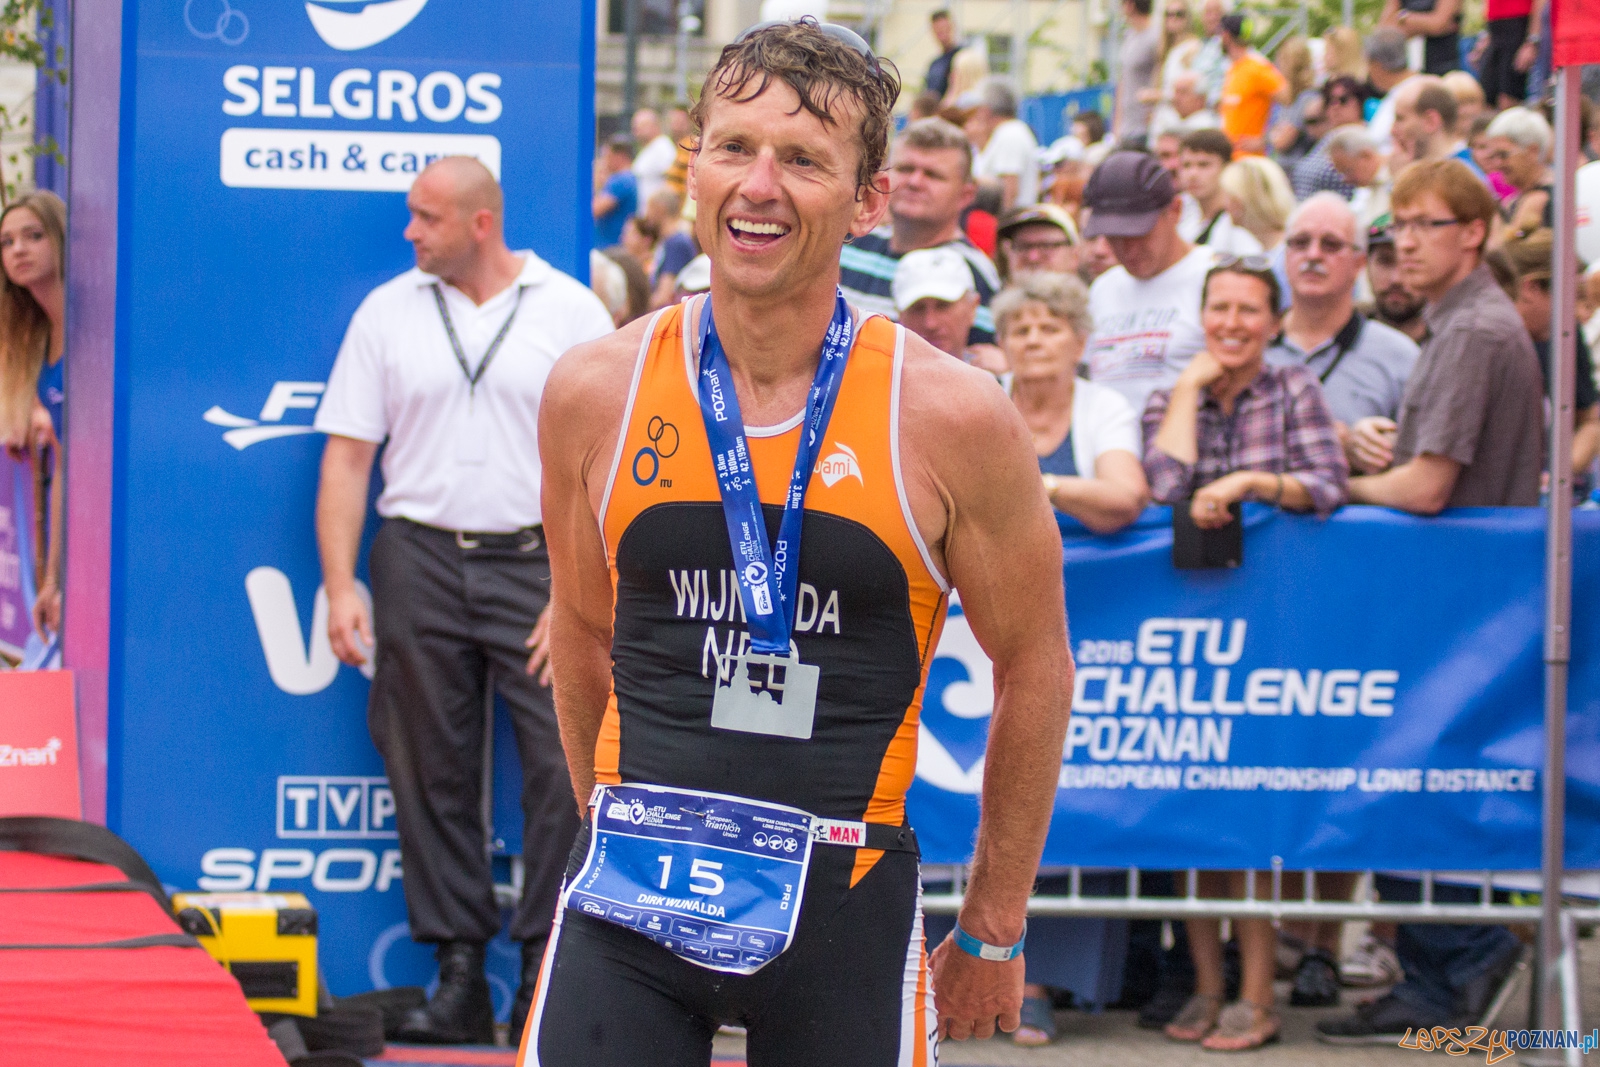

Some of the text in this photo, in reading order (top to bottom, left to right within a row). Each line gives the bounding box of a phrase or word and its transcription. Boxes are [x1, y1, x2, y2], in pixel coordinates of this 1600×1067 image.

[222, 65, 503, 124] SELGROS
[244, 143, 329, 170] cash
[341, 144, 367, 172] &
[717, 453, 729, 478] 3,8km
[727, 449, 739, 475] 180km
[735, 435, 750, 472] 42,195km
[791, 484, 803, 509] 3,8km
[741, 521, 755, 562] CHALLENGE
[669, 569, 841, 634] WIJNDA
[1076, 618, 1247, 665] 2016 ETU
[1072, 666, 1399, 717] CHALLENGE
[1063, 715, 1233, 762] POZNAN
[1058, 764, 1535, 792] EUROPEAN CHAMPIONSHIP LONG DISTANCE
[286, 787, 397, 829] TVP
[704, 820, 741, 833] Triathlon
[722, 831, 738, 839] Union
[829, 826, 860, 844] MAN
[584, 837, 608, 889] 24.07.2016
[583, 904, 605, 916] Enea
[637, 894, 666, 907] DIRK
[779, 884, 793, 910] PRO
